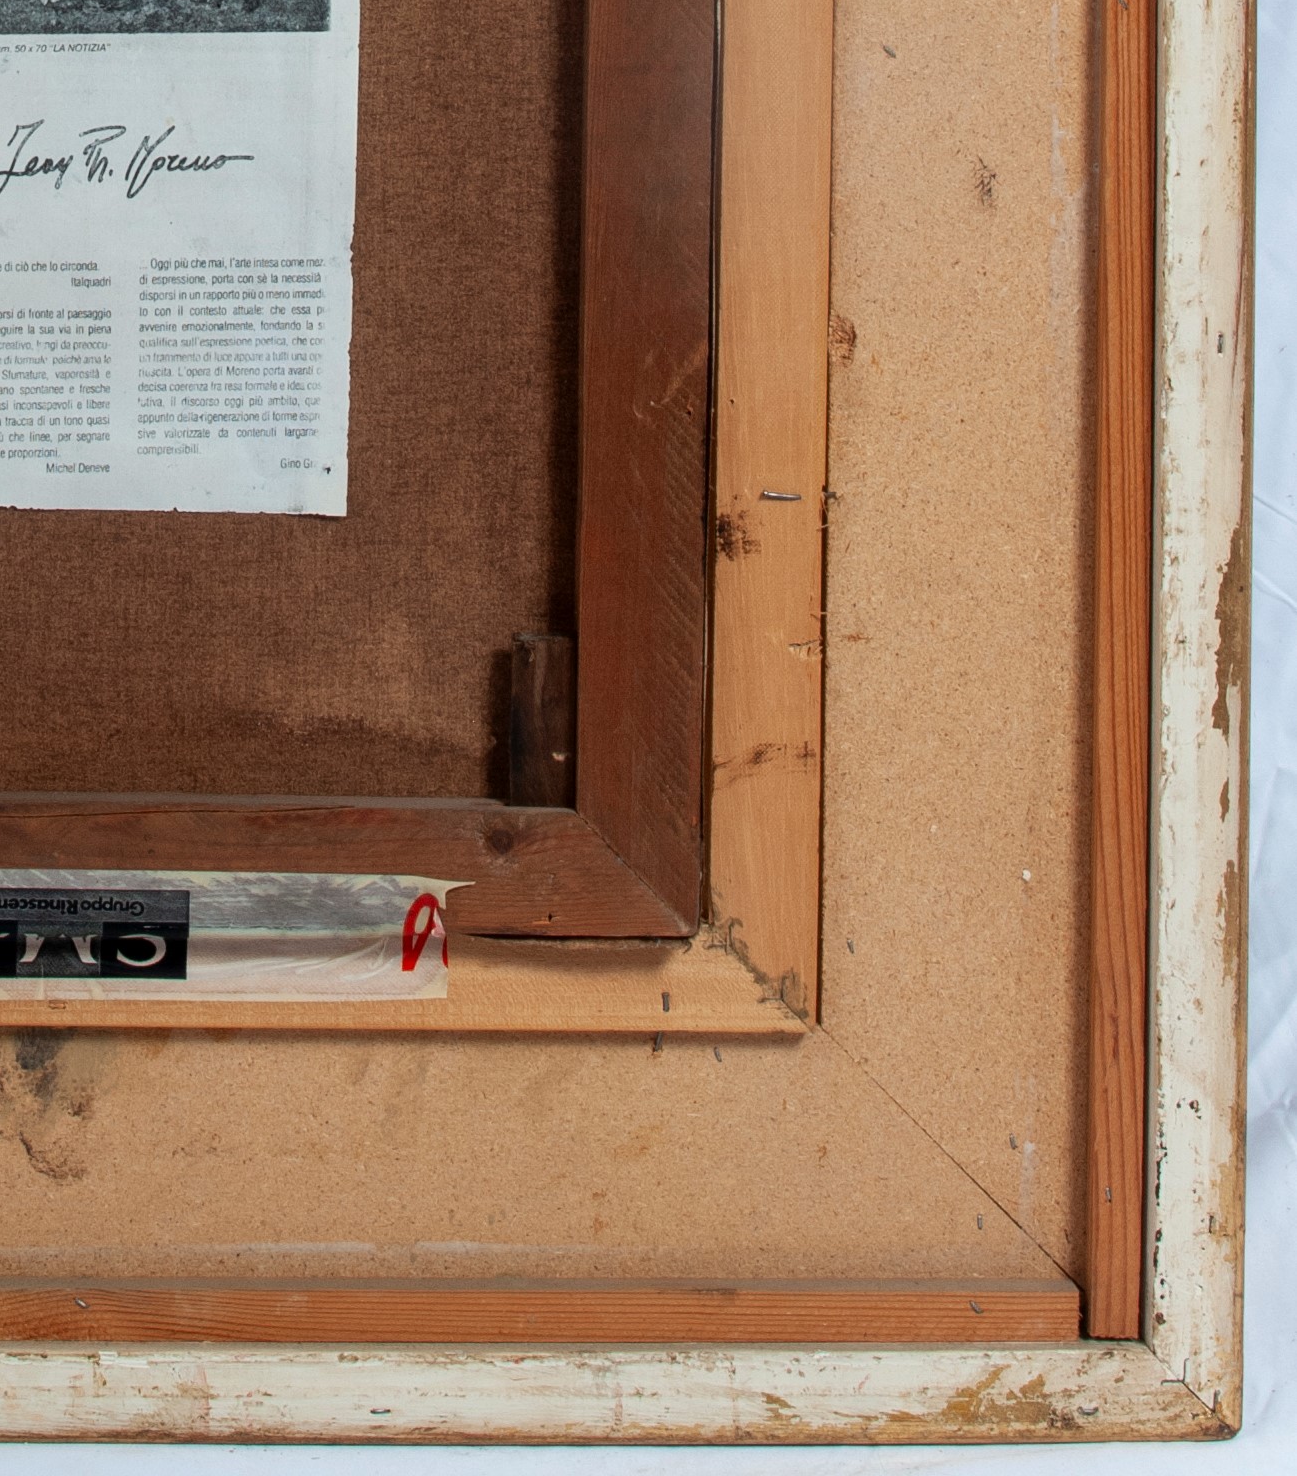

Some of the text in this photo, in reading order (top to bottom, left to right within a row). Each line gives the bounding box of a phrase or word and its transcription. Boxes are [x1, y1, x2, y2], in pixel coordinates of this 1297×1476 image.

[14, 43, 27, 53] 50
[28, 45, 34, 53] x
[36, 43, 48, 53] 70
[4, 261, 13, 273] di
[15, 260, 29, 273] ciò
[31, 261, 47, 273] che
[49, 260, 58, 272] lo
[150, 257, 304, 272] Oggi più che mai, l'arte intesa come
[45, 462, 76, 474] Michel
[80, 896, 145, 917] Gruppo
